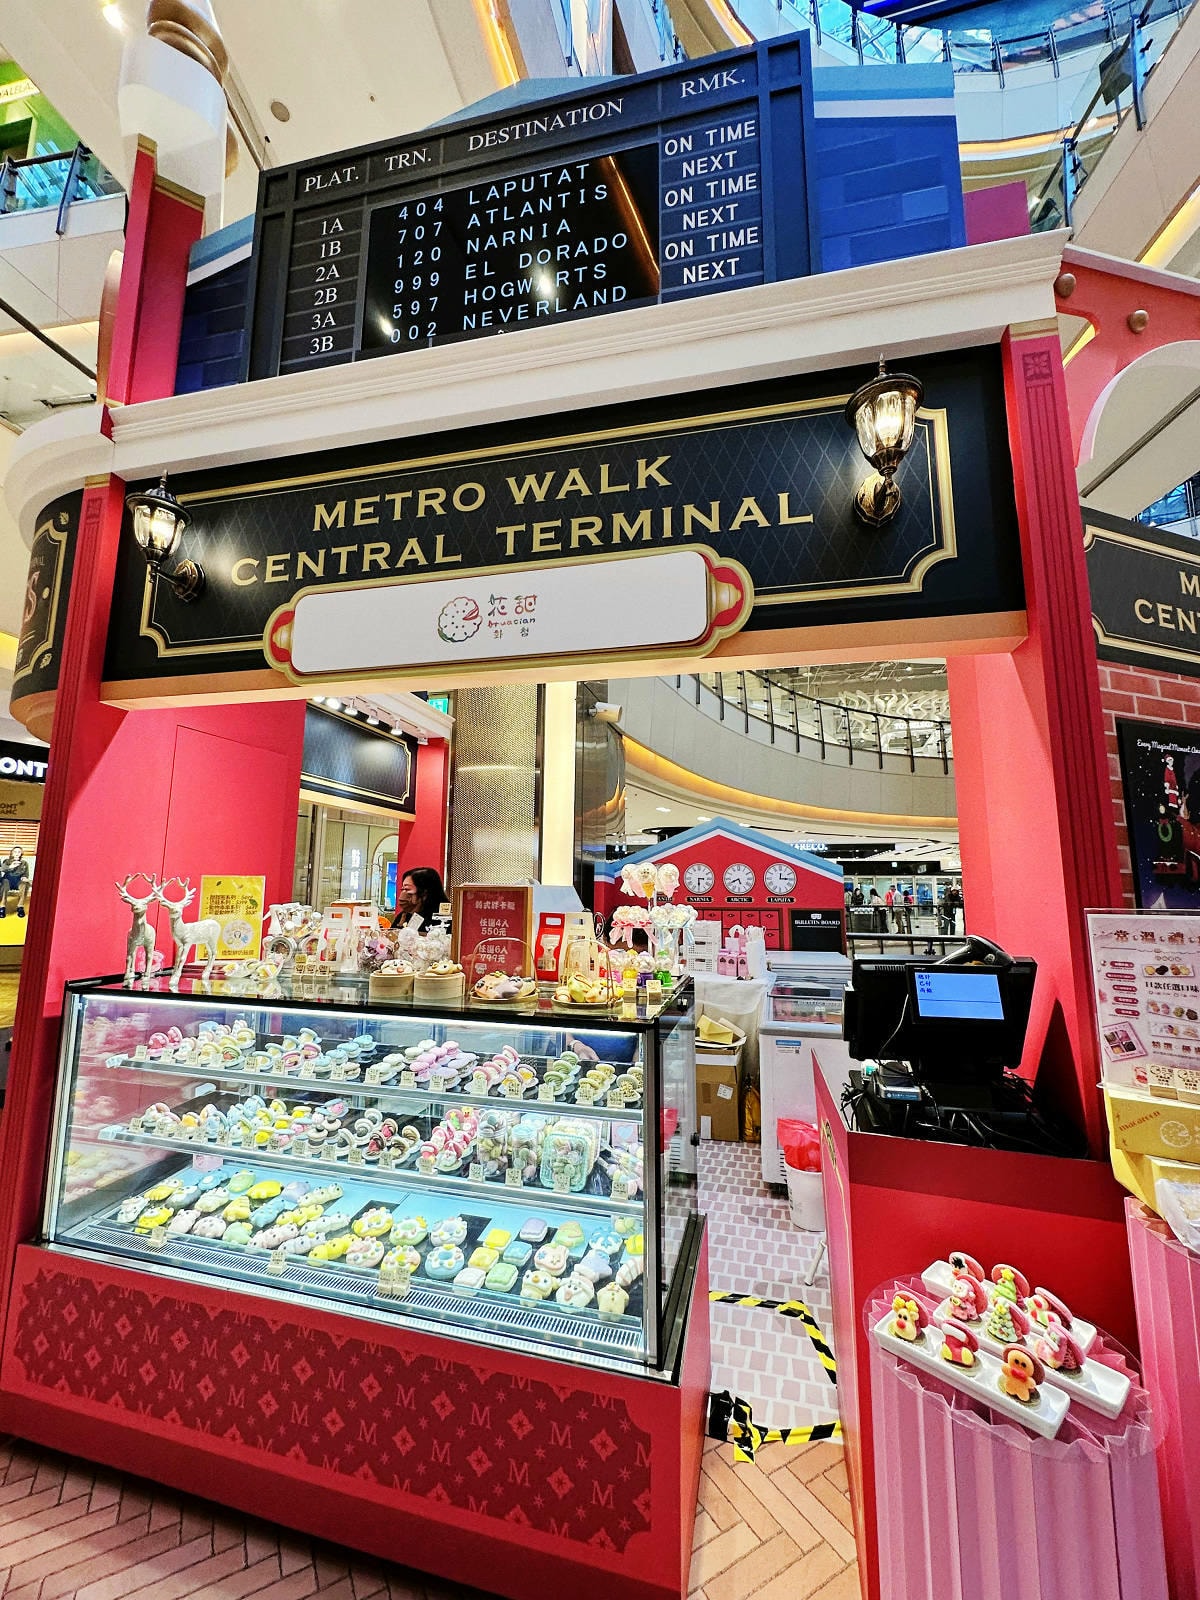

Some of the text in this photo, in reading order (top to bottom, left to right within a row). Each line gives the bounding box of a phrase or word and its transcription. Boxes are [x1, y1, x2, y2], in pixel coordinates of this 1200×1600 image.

[304, 68, 746, 192] PLAT. TRN. DESTINATION RMK.
[322, 217, 344, 236] 1A
[469, 163, 590, 206] LAPUTAT
[664, 135, 693, 156] ON
[705, 120, 756, 146] TIME
[313, 287, 338, 306] 2B
[465, 261, 496, 280] EL
[519, 233, 627, 269] DORADO
[682, 203, 738, 230] NEXT
[315, 264, 340, 283] 2A
[466, 218, 571, 254] NARNIA
[664, 186, 693, 207] ON
[706, 172, 757, 198] TIME
[321, 240, 341, 259] 1B
[467, 184, 608, 229] ATLANTIS
[682, 150, 738, 178] NEXT
[310, 335, 334, 354] 3B
[463, 286, 627, 331] NEVERLAND
[683, 257, 740, 285] NEXT
[311, 312, 336, 330] 3A
[664, 239, 694, 260] ON
[707, 226, 759, 252] TIME
[231, 492, 814, 587] CENTRAL TERMINAL
[312, 455, 672, 532] METRO WALK
[1134, 598, 1200, 634] CEN
[1178, 570, 1200, 598] M
[481, 927, 507, 936] 550元
